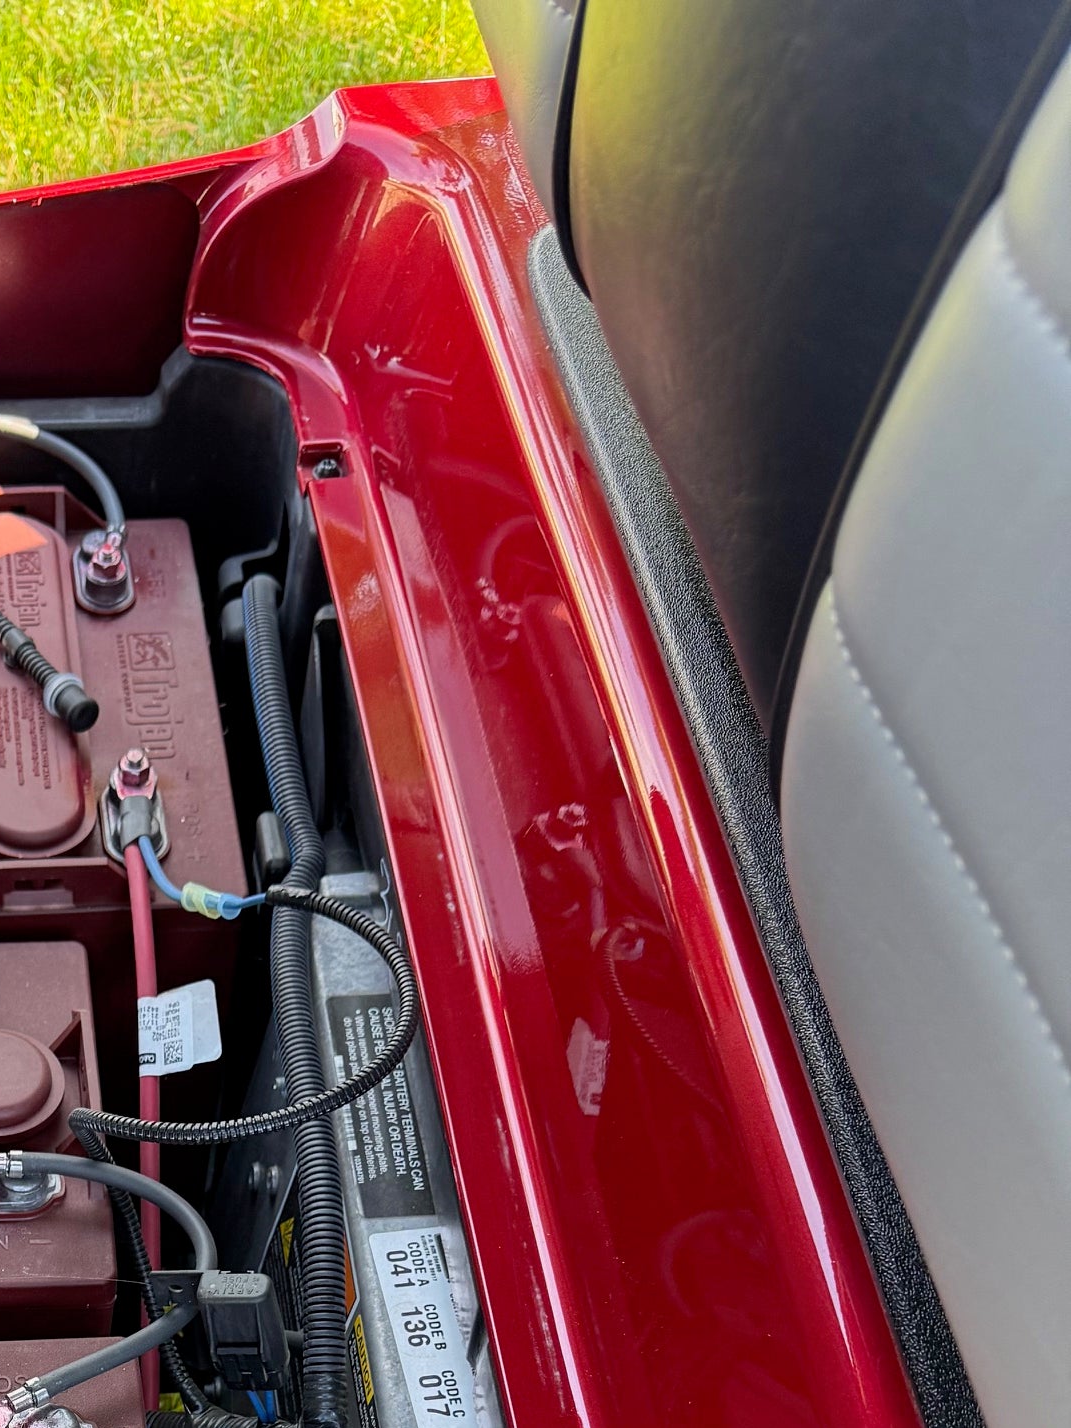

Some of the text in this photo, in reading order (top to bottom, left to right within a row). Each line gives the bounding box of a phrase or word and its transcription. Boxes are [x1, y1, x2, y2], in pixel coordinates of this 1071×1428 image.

[12, 574, 47, 626] Trojan
[126, 670, 183, 759] Trojan
[343, 1017, 352, 1027] do
[345, 1041, 357, 1061] place
[346, 1029, 355, 1040] not
[355, 1016, 388, 1174] When mounting plate.
[359, 1111, 367, 1120] on
[368, 1008, 406, 1177] CAUSE INJURY OR DEATH.
[359, 1122, 369, 1134] top
[393, 1070, 424, 1191] BATTERY TERMINALS CAN
[364, 1145, 377, 1181] batteries.
[356, 1323, 372, 1398] CAUTION
[387, 1251, 450, 1417] 041 136 017
[408, 1242, 465, 1418] CODE A CODE B CODE C
